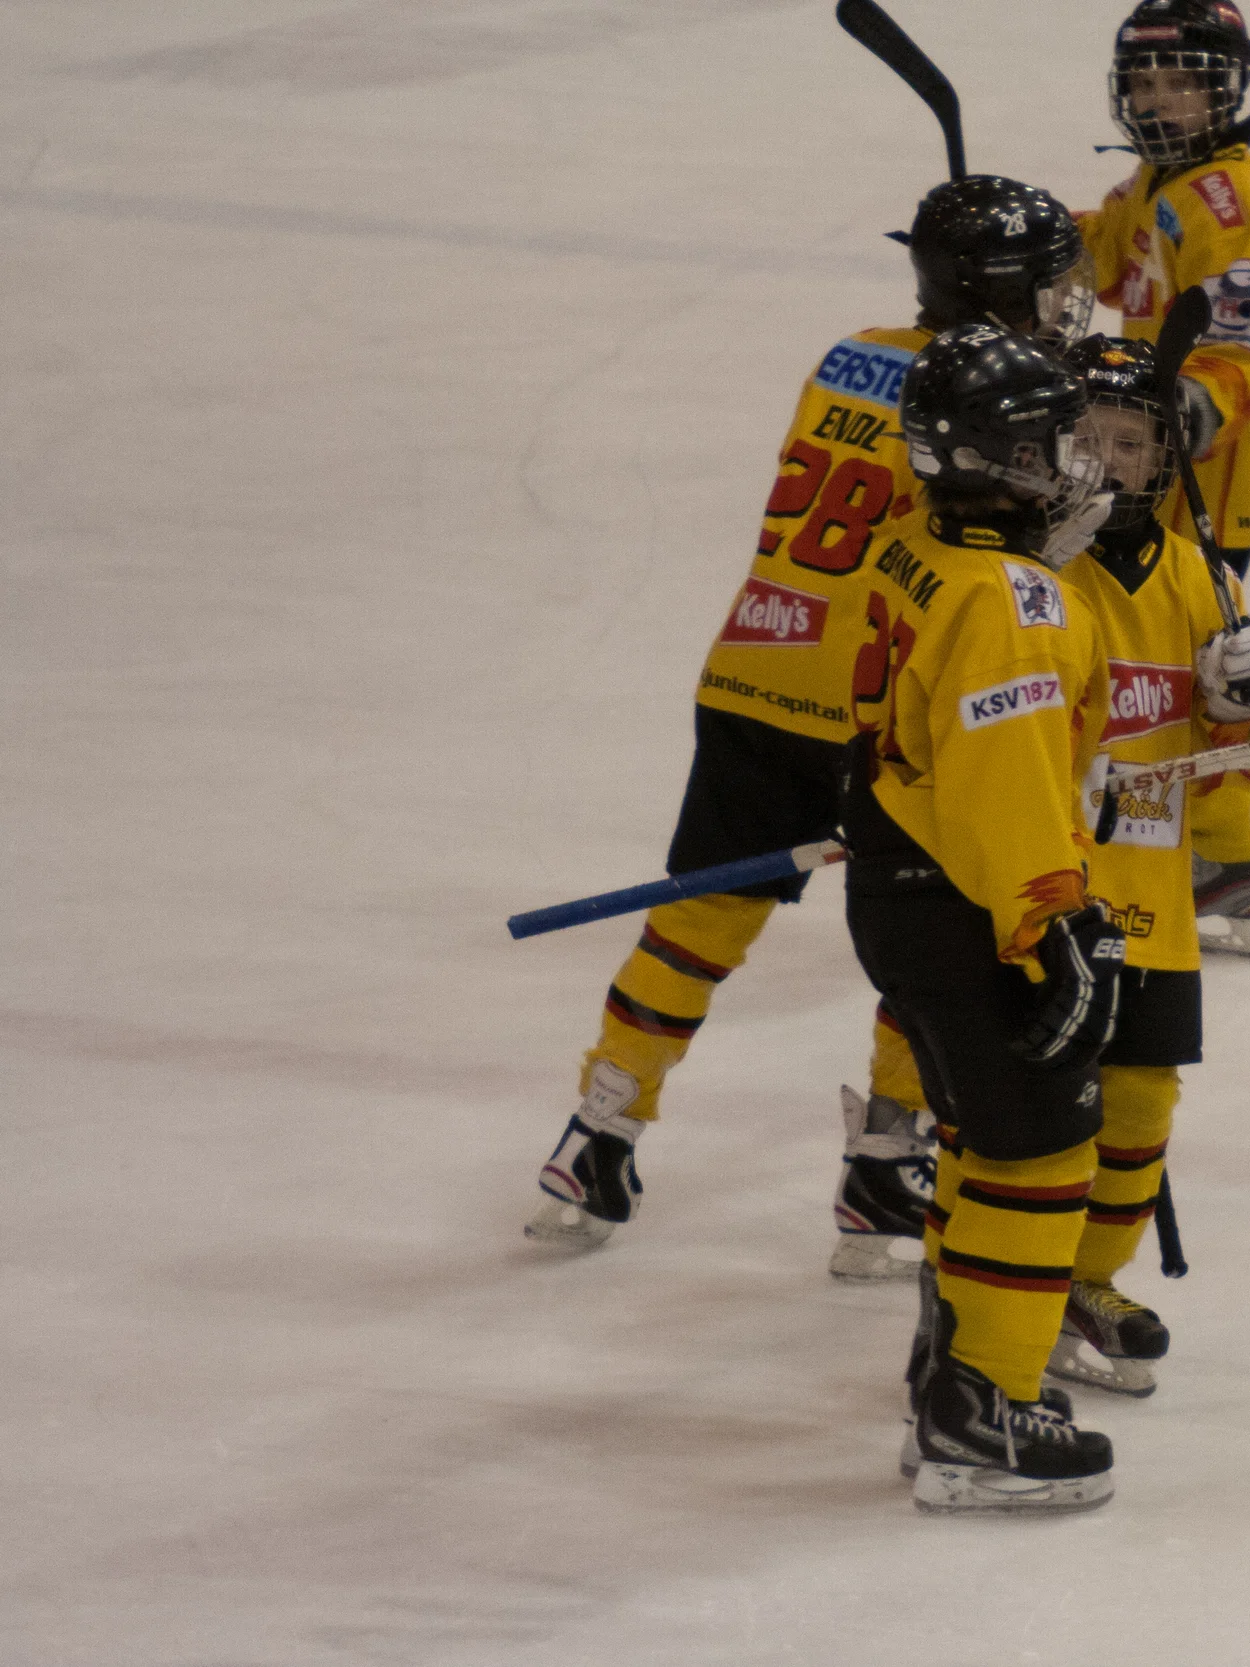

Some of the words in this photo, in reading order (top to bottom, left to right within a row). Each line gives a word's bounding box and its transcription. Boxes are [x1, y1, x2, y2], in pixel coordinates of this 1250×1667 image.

[1001, 212, 1028, 237] 28
[1087, 368, 1136, 386] Reebok
[811, 405, 889, 453] ENDL
[758, 438, 895, 577] 28
[735, 591, 811, 639] Kelly's
[1109, 674, 1173, 723] Kelly's
[1125, 822, 1157, 835] ROT
